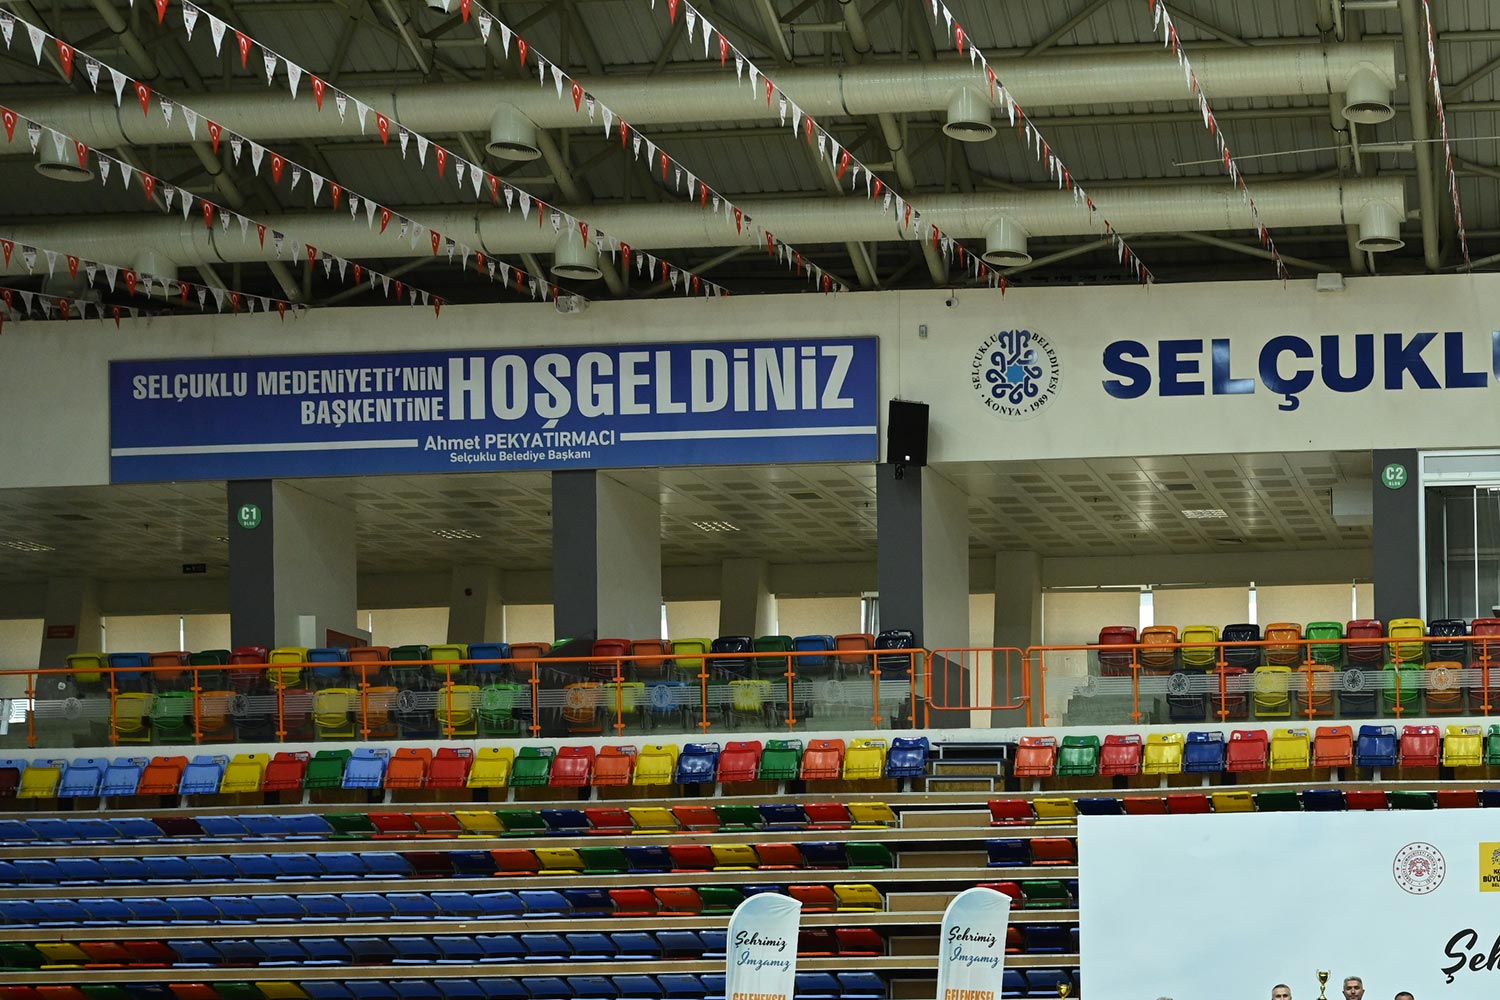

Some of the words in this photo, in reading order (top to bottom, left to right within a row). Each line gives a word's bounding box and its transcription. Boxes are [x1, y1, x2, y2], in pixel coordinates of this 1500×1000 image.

[972, 333, 998, 390] SELÇUKLU
[132, 372, 248, 402] SELÇUKLU
[256, 366, 445, 396] MEDENİYETİ'NİN
[447, 345, 855, 429] HOŞGELDİNİZ
[300, 396, 445, 428] BAŞKENTİNE
[984, 397, 1022, 416] KONYA
[1029, 394, 1049, 412] 1989
[424, 434, 481, 451] Ahmet
[484, 430, 615, 450] PEKYATIRMACI
[449, 452, 497, 465] Selçuklu
[498, 450, 546, 463] Belediye
[548, 449, 591, 461] Başkanı
[1386, 467, 1404, 480] C2
[241, 507, 257, 520] C1
[735, 930, 788, 952] Şehrimiz
[948, 926, 997, 947] Şehrimiz
[736, 947, 791, 972] İmzamız
[949, 943, 1000, 969] İmzamız
